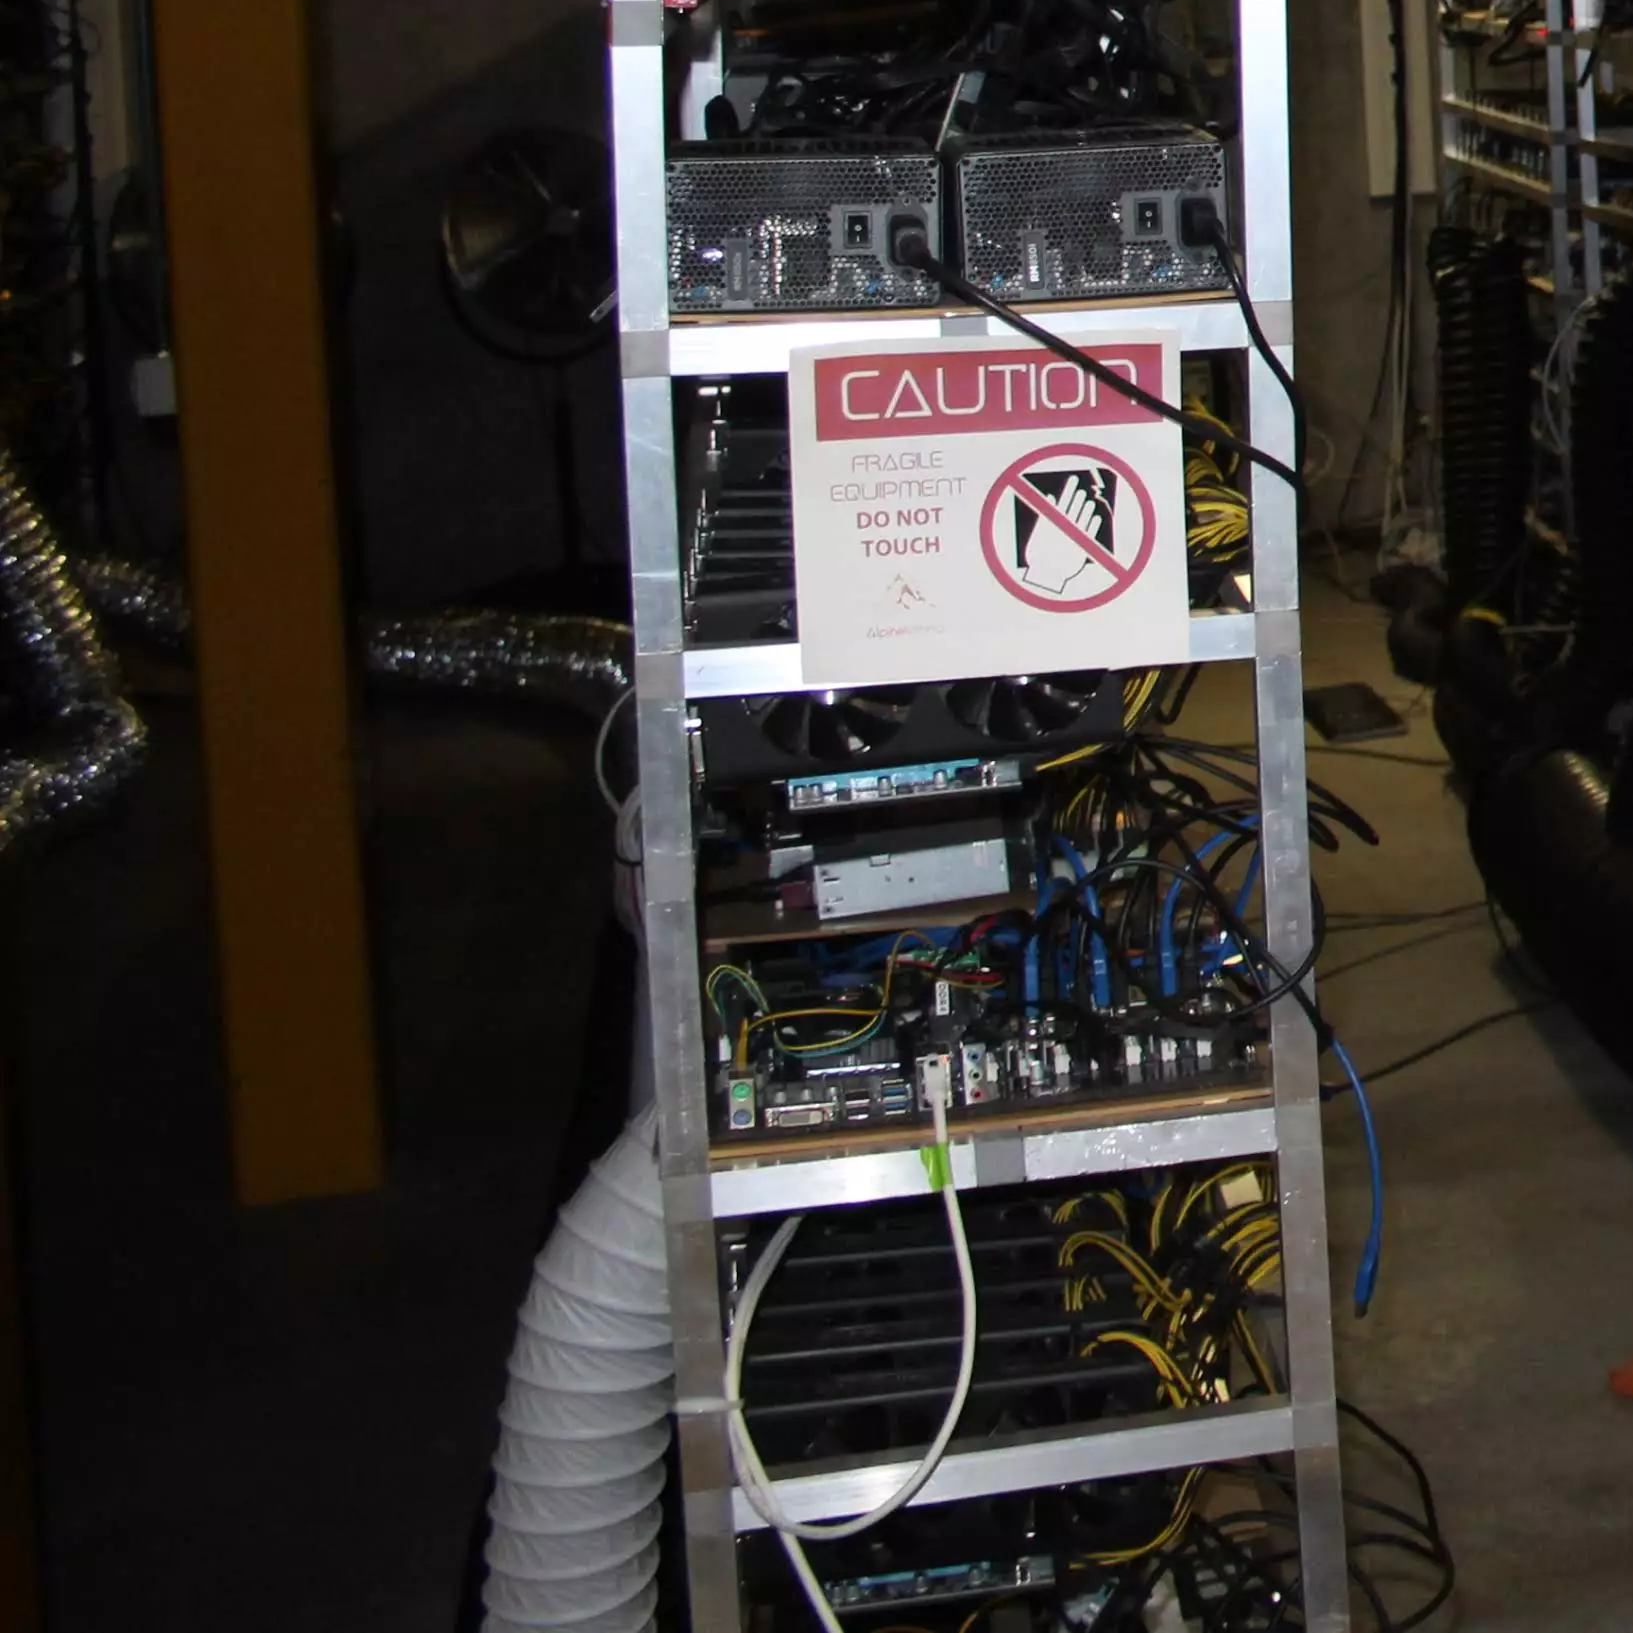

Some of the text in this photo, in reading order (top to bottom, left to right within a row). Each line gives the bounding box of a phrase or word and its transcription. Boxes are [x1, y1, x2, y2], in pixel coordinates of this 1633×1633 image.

[841, 359, 1138, 420] CAUTION
[851, 451, 944, 473] FRAGILE
[830, 477, 967, 502] EQUIPMENT
[856, 507, 944, 530] DO NOT
[861, 535, 941, 558] TOUCH
